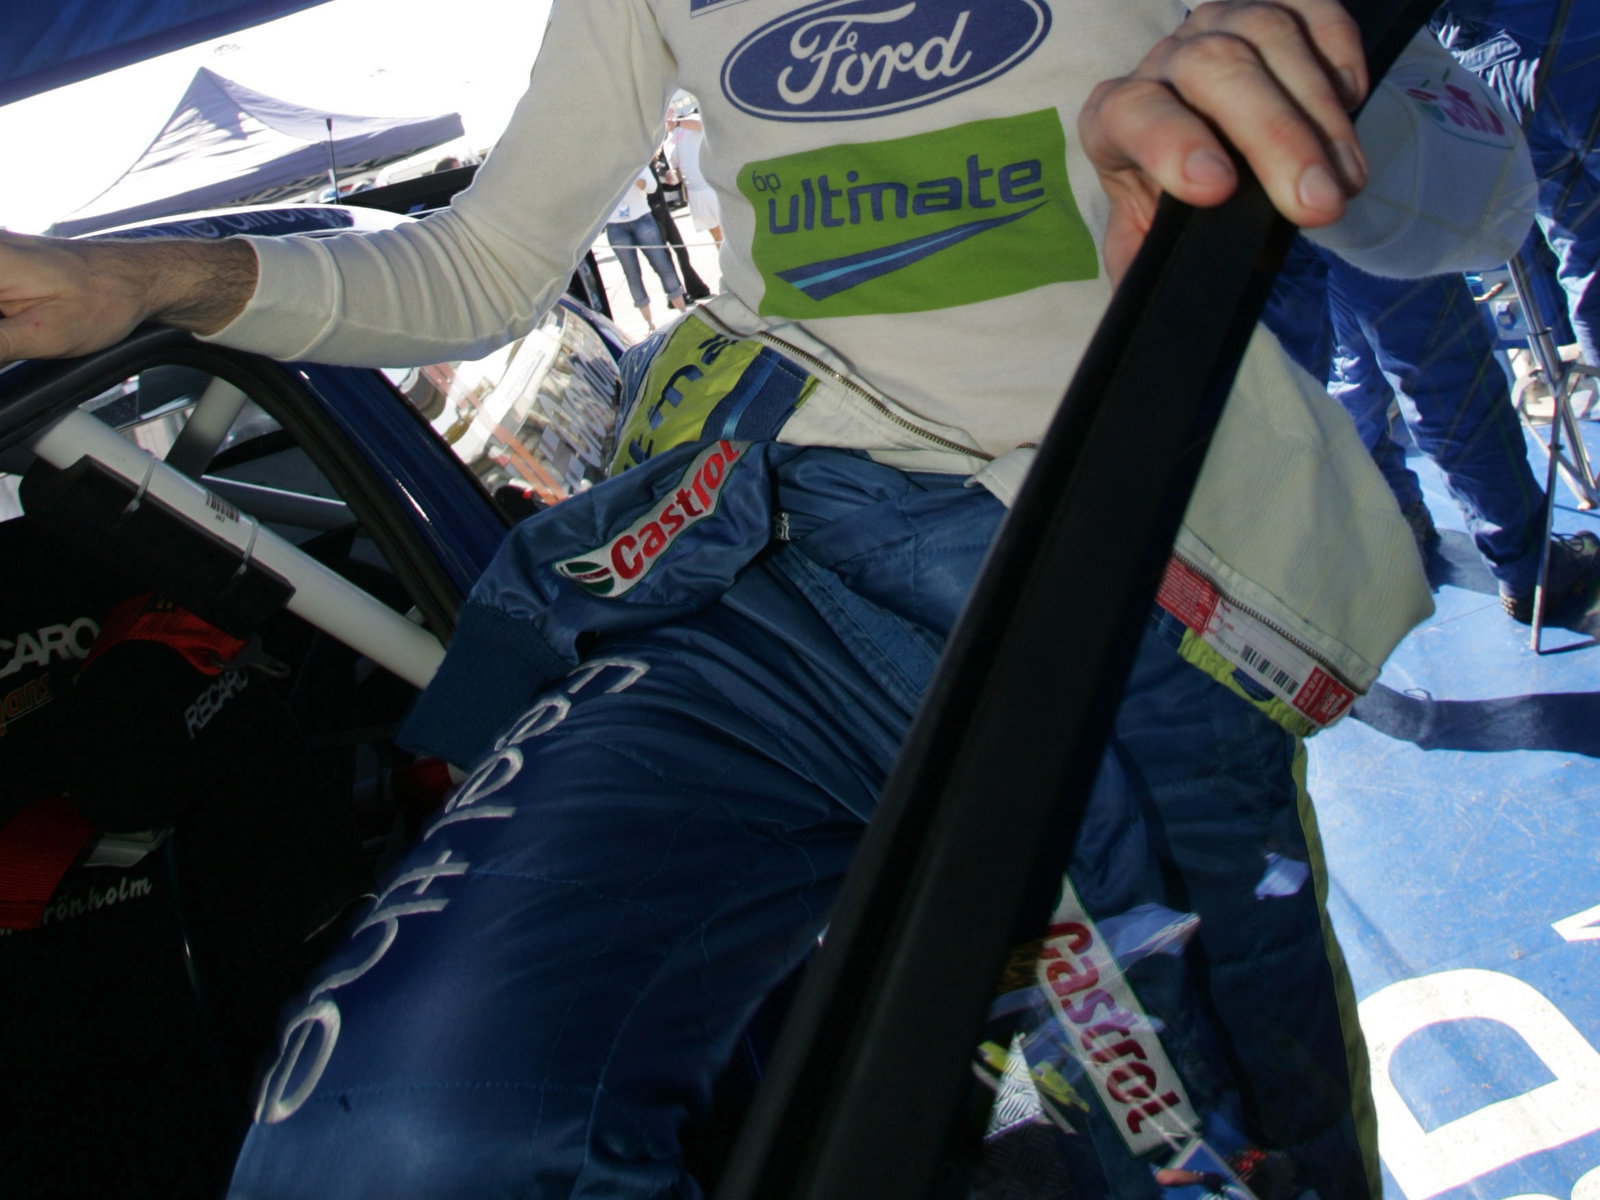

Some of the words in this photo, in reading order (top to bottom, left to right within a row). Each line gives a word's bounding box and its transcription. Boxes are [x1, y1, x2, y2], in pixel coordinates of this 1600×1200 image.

[777, 1, 972, 105] Ford
[751, 168, 782, 194] bp
[768, 154, 1046, 235] ultimate
[610, 439, 741, 580] Castrol
[184, 663, 249, 740] RECARO
[1041, 921, 1181, 1135] Castrol
